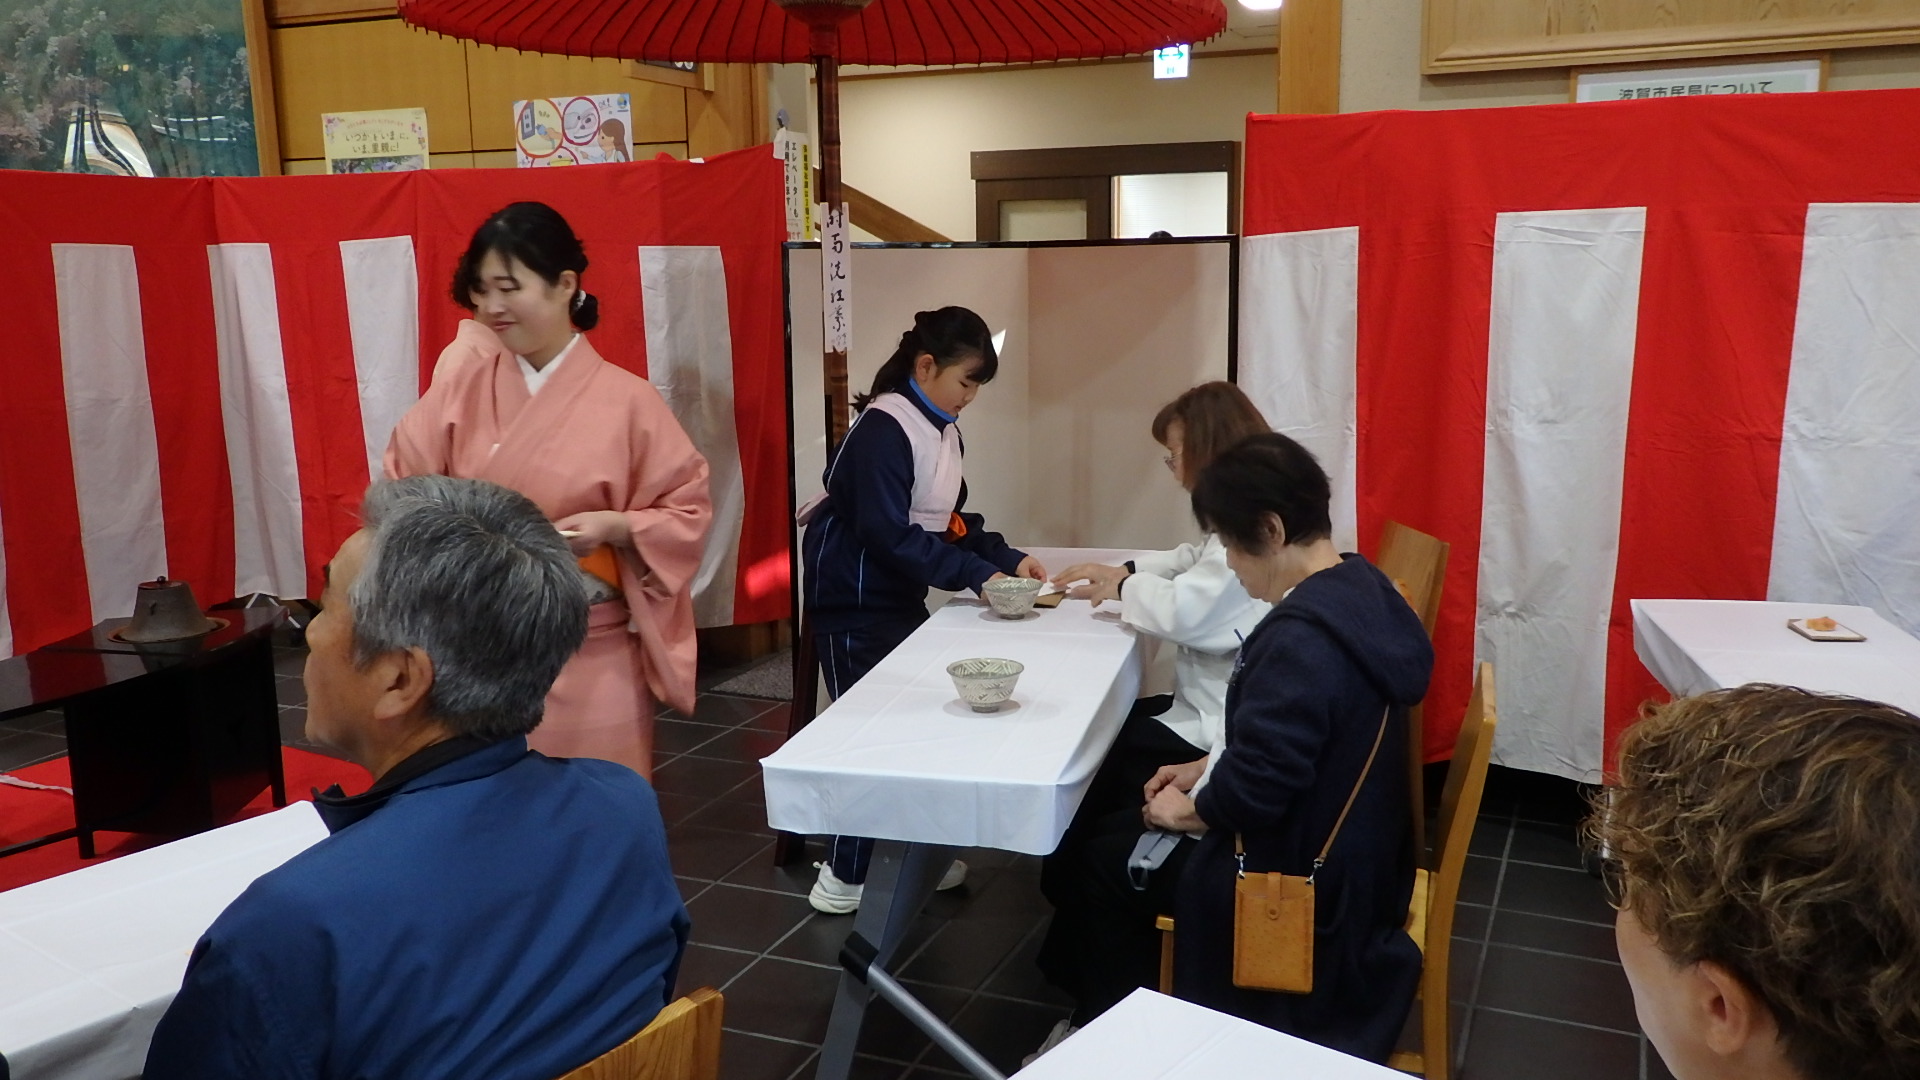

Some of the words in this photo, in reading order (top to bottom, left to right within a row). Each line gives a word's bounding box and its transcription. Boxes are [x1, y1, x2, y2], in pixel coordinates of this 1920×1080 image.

[791, 142, 799, 218] エレベーターも
